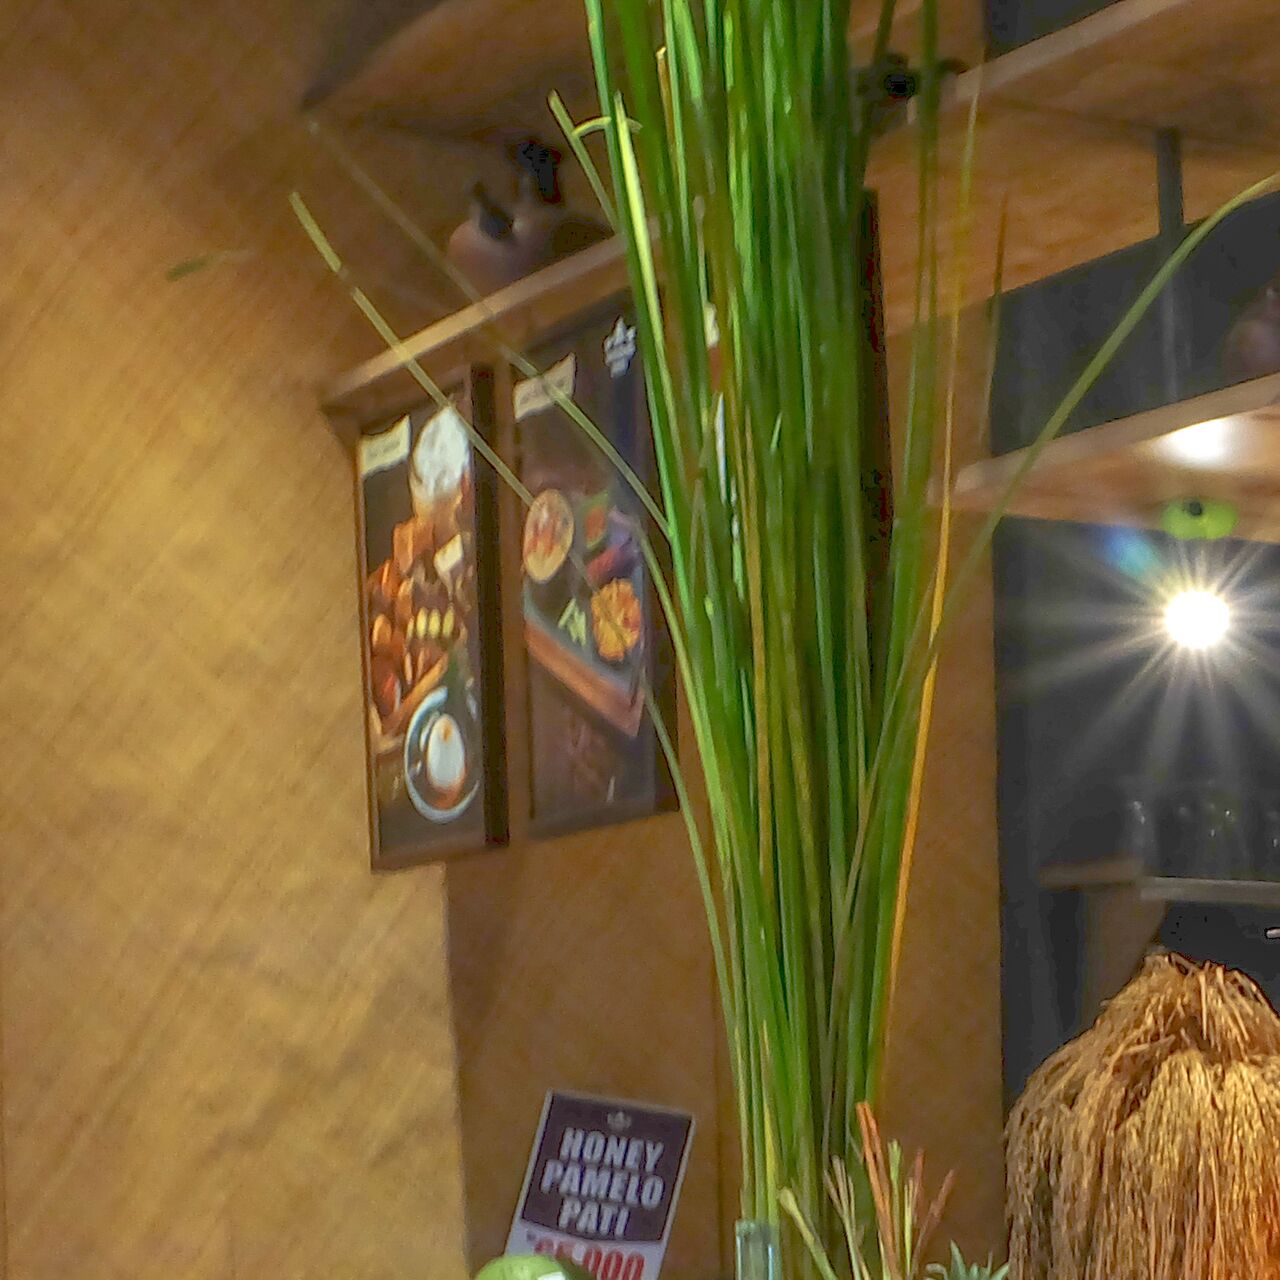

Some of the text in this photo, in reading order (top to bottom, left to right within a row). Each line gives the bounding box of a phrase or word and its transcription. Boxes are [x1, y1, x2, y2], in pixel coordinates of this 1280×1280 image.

[559, 1126, 664, 1173] HONEY
[540, 1158, 665, 1209] PAMELO
[558, 1196, 631, 1238] PATI
